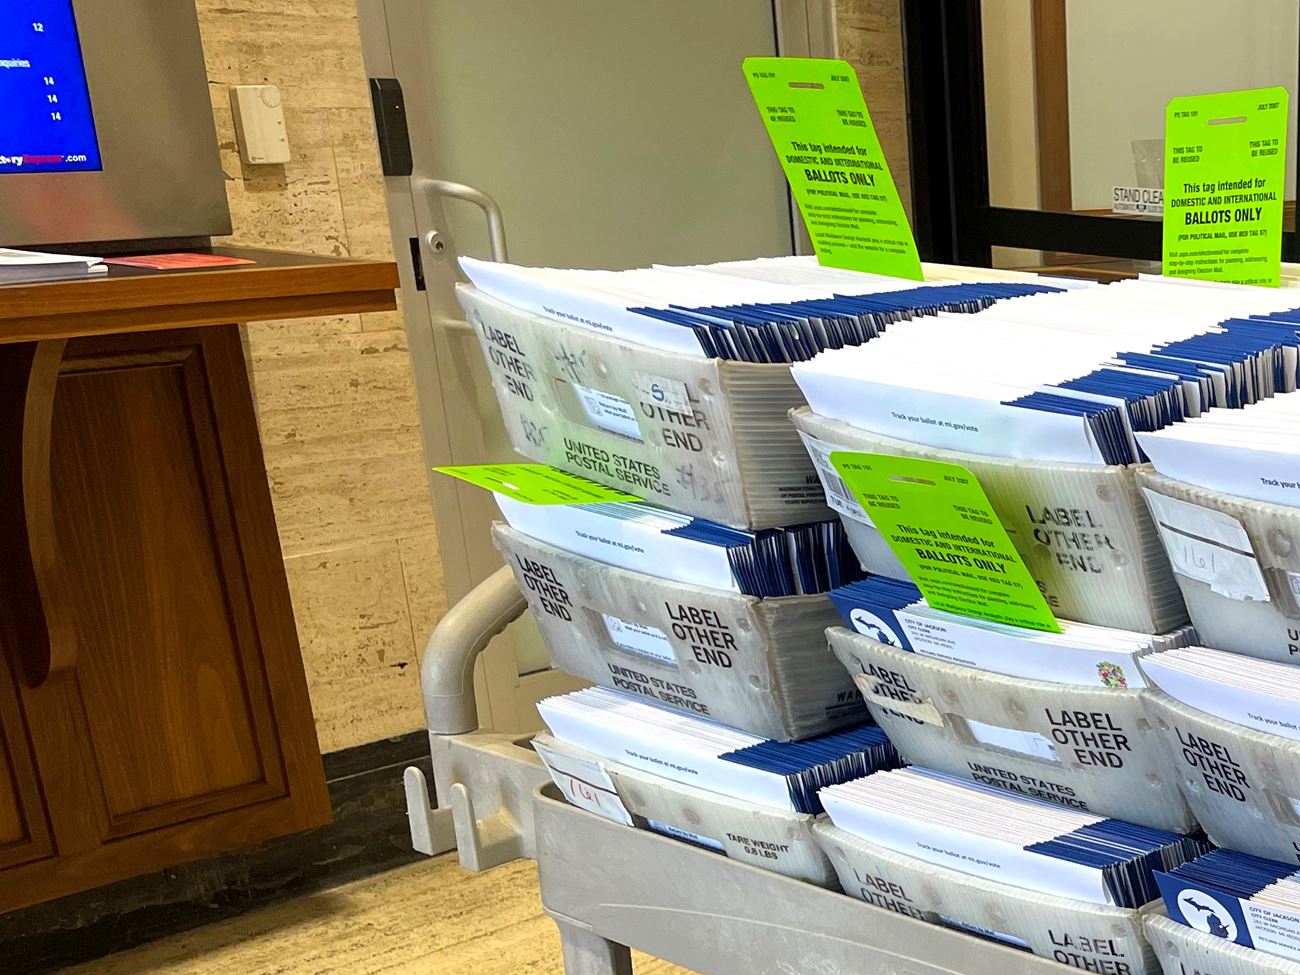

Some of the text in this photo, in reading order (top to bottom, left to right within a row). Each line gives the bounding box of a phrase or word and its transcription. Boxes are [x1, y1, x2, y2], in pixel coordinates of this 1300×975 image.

[33, 23, 44, 32] 12
[44, 77, 54, 85] 14
[48, 95, 58, 103] 14
[51, 112, 61, 120] 14
[791, 142, 867, 156] This tag intended for
[805, 169, 875, 186] BALLOTS ONLY
[1184, 178, 1266, 194] This tag intended for
[1114, 188, 1164, 204] STAND CLEA
[1171, 197, 1206, 208] DOMESTIC
[1208, 197, 1222, 205] AND
[1224, 192, 1277, 204] INTERNATIONAL
[1185, 207, 1262, 225] BALLOTS ONLY
[481, 322, 526, 356] LABEL
[489, 346, 538, 381] OTHER
[505, 376, 534, 401] END
[662, 428, 703, 452] END
[563, 438, 661, 480] UNITED STATES
[566, 451, 611, 479] POSTAL
[615, 468, 672, 496] SERVICE
[1260, 478, 1278, 487] Track
[1280, 481, 1296, 491] your
[1026, 505, 1103, 528] LABEL
[892, 535, 1016, 563] DOMESTIC AND INTERNATIONAL
[897, 525, 995, 548] This tag intended for
[515, 553, 563, 587] LABEL
[916, 549, 1007, 574] BALLOTS ONLY
[523, 573, 573, 607] OTHER
[540, 597, 572, 622] END
[665, 601, 729, 629] LABEL
[672, 623, 739, 651] OTHER
[692, 645, 732, 668] END
[607, 663, 696, 699] UNITED STATES
[861, 663, 917, 693] LABEL
[612, 676, 710, 715] POSTAL SERVICE
[1045, 708, 1122, 731] LABEL
[1051, 729, 1131, 751] OTHER
[1175, 727, 1240, 767] LABEL
[1074, 750, 1123, 768] END
[1182, 748, 1250, 788] OTHER
[968, 762, 1076, 797] UNITED STATES
[972, 773, 1088, 809] POSTAL SERVICE
[1204, 774, 1246, 801] END
[727, 833, 789, 853] TARE WEIGHT
[853, 868, 913, 903] LABEL
[1048, 929, 1124, 958] LABEL
